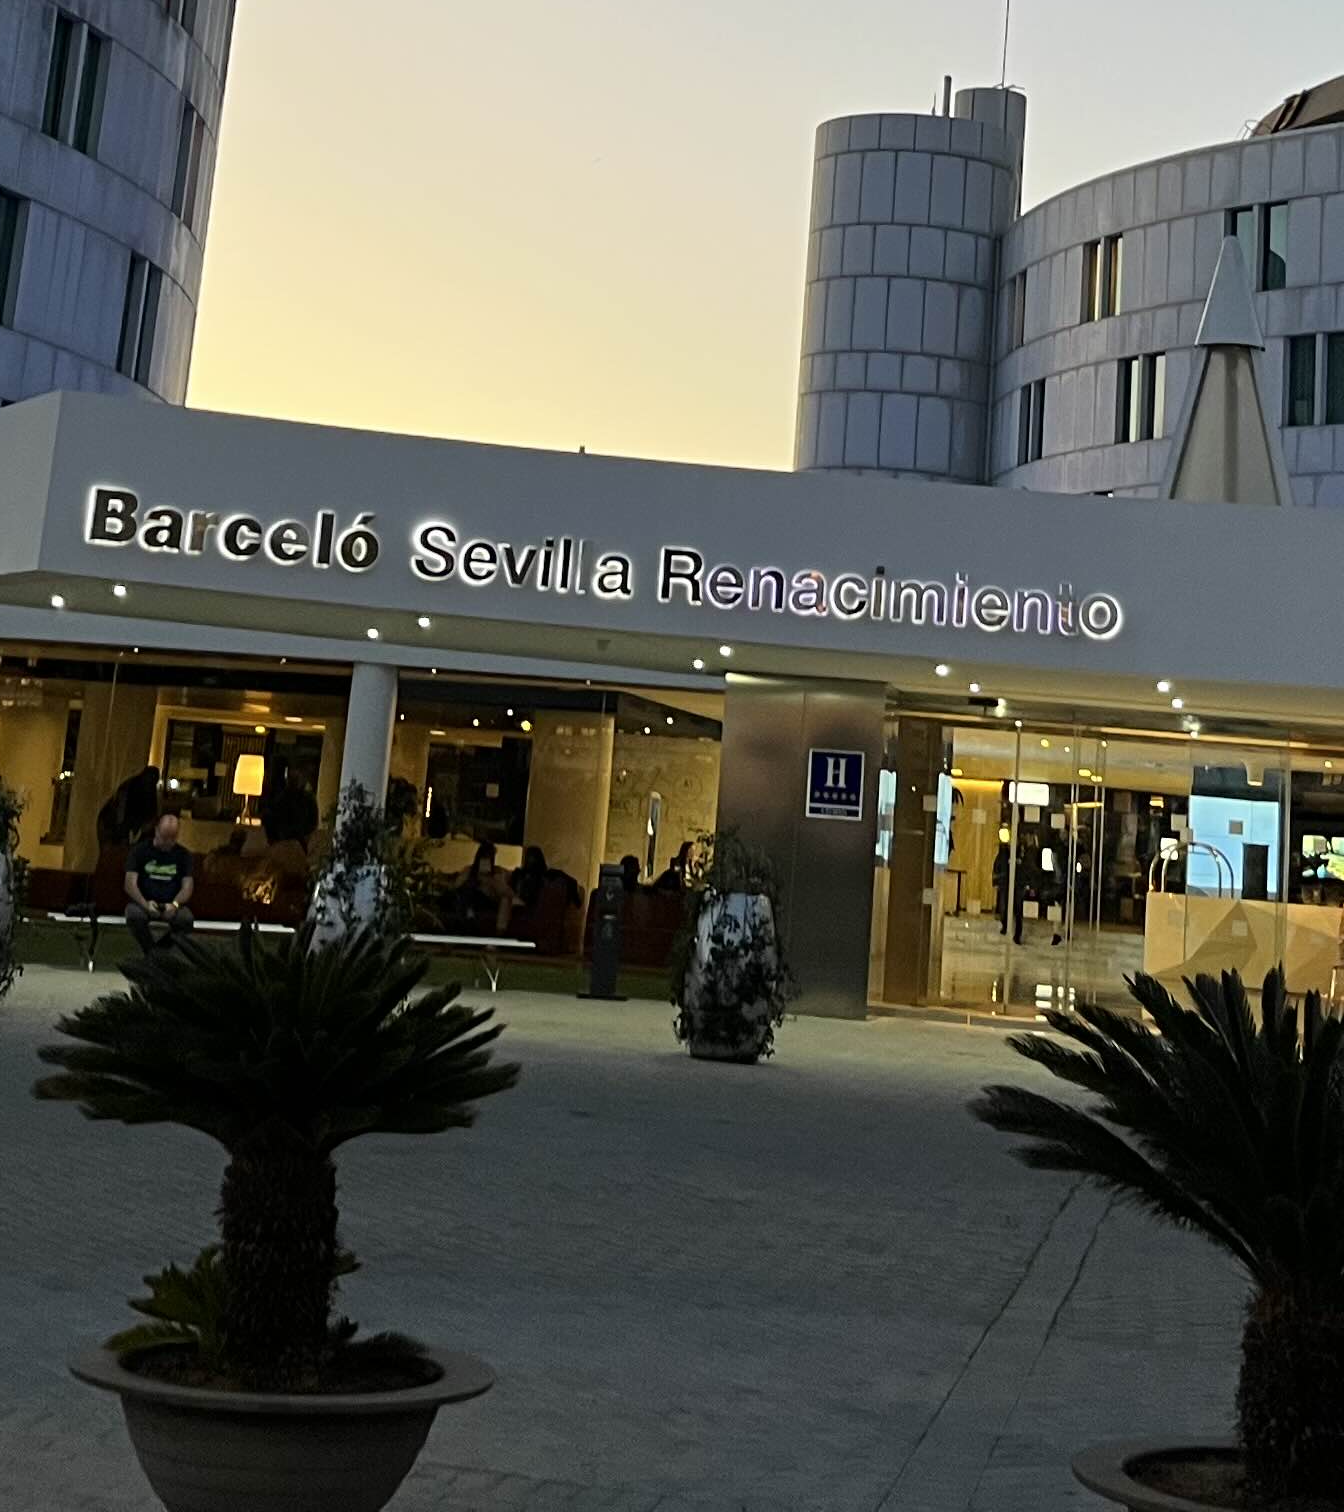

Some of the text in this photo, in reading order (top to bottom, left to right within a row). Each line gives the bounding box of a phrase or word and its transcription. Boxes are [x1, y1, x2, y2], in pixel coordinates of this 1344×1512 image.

[87, 487, 1123, 638] Barceló Sevilla Renacimiento
[825, 757, 847, 788] H
